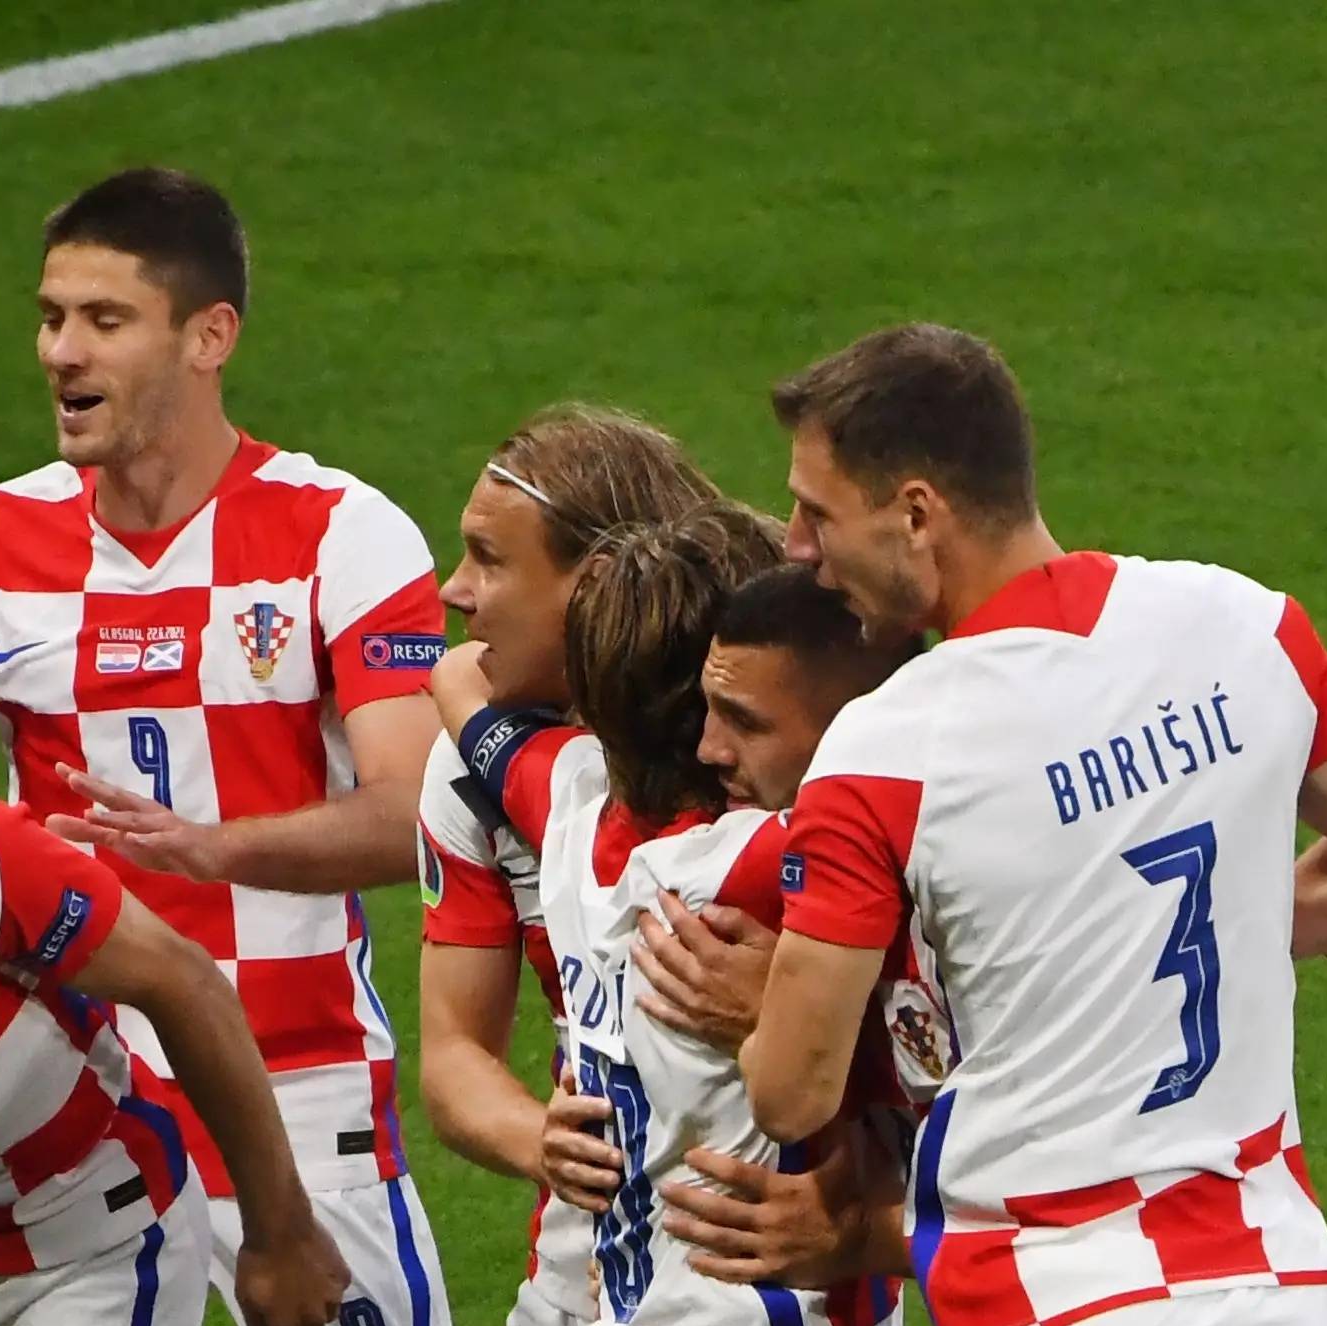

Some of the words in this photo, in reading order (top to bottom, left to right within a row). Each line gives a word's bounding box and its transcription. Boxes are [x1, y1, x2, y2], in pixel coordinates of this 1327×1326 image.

[393, 644, 447, 660] RESPE
[127, 716, 174, 813] 9
[475, 723, 514, 776] SPECT
[1045, 682, 1243, 826] BARIŠIĆ
[1120, 820, 1221, 1116] 3
